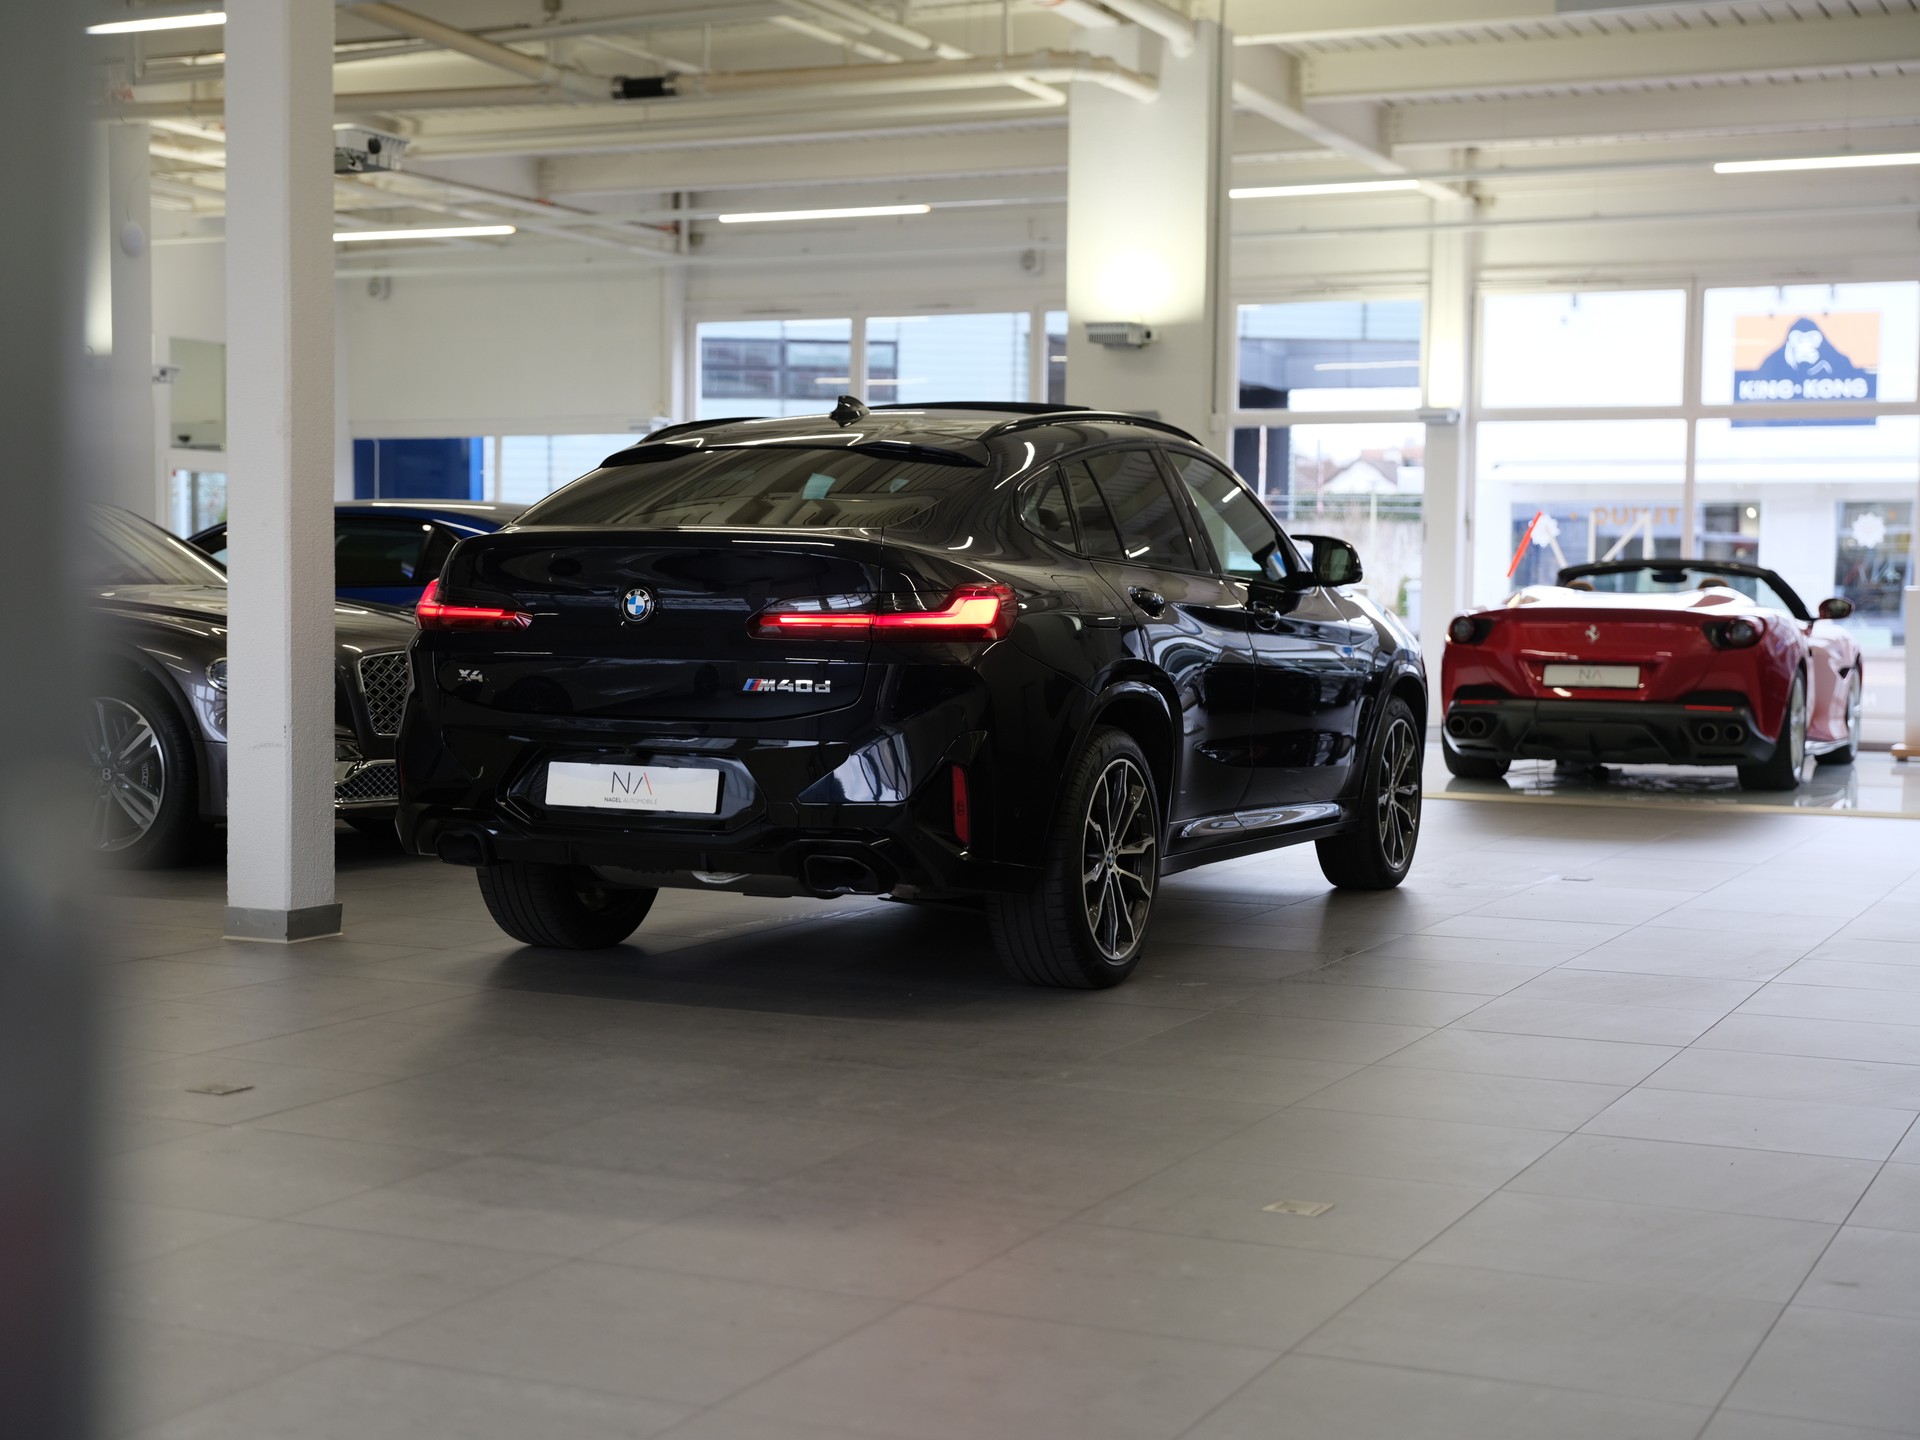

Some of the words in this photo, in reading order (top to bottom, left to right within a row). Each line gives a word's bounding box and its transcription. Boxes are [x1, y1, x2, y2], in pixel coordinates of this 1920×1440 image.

[1592, 506, 1680, 526] OUTET
[458, 669, 483, 682] X4
[757, 678, 831, 693] M40d
